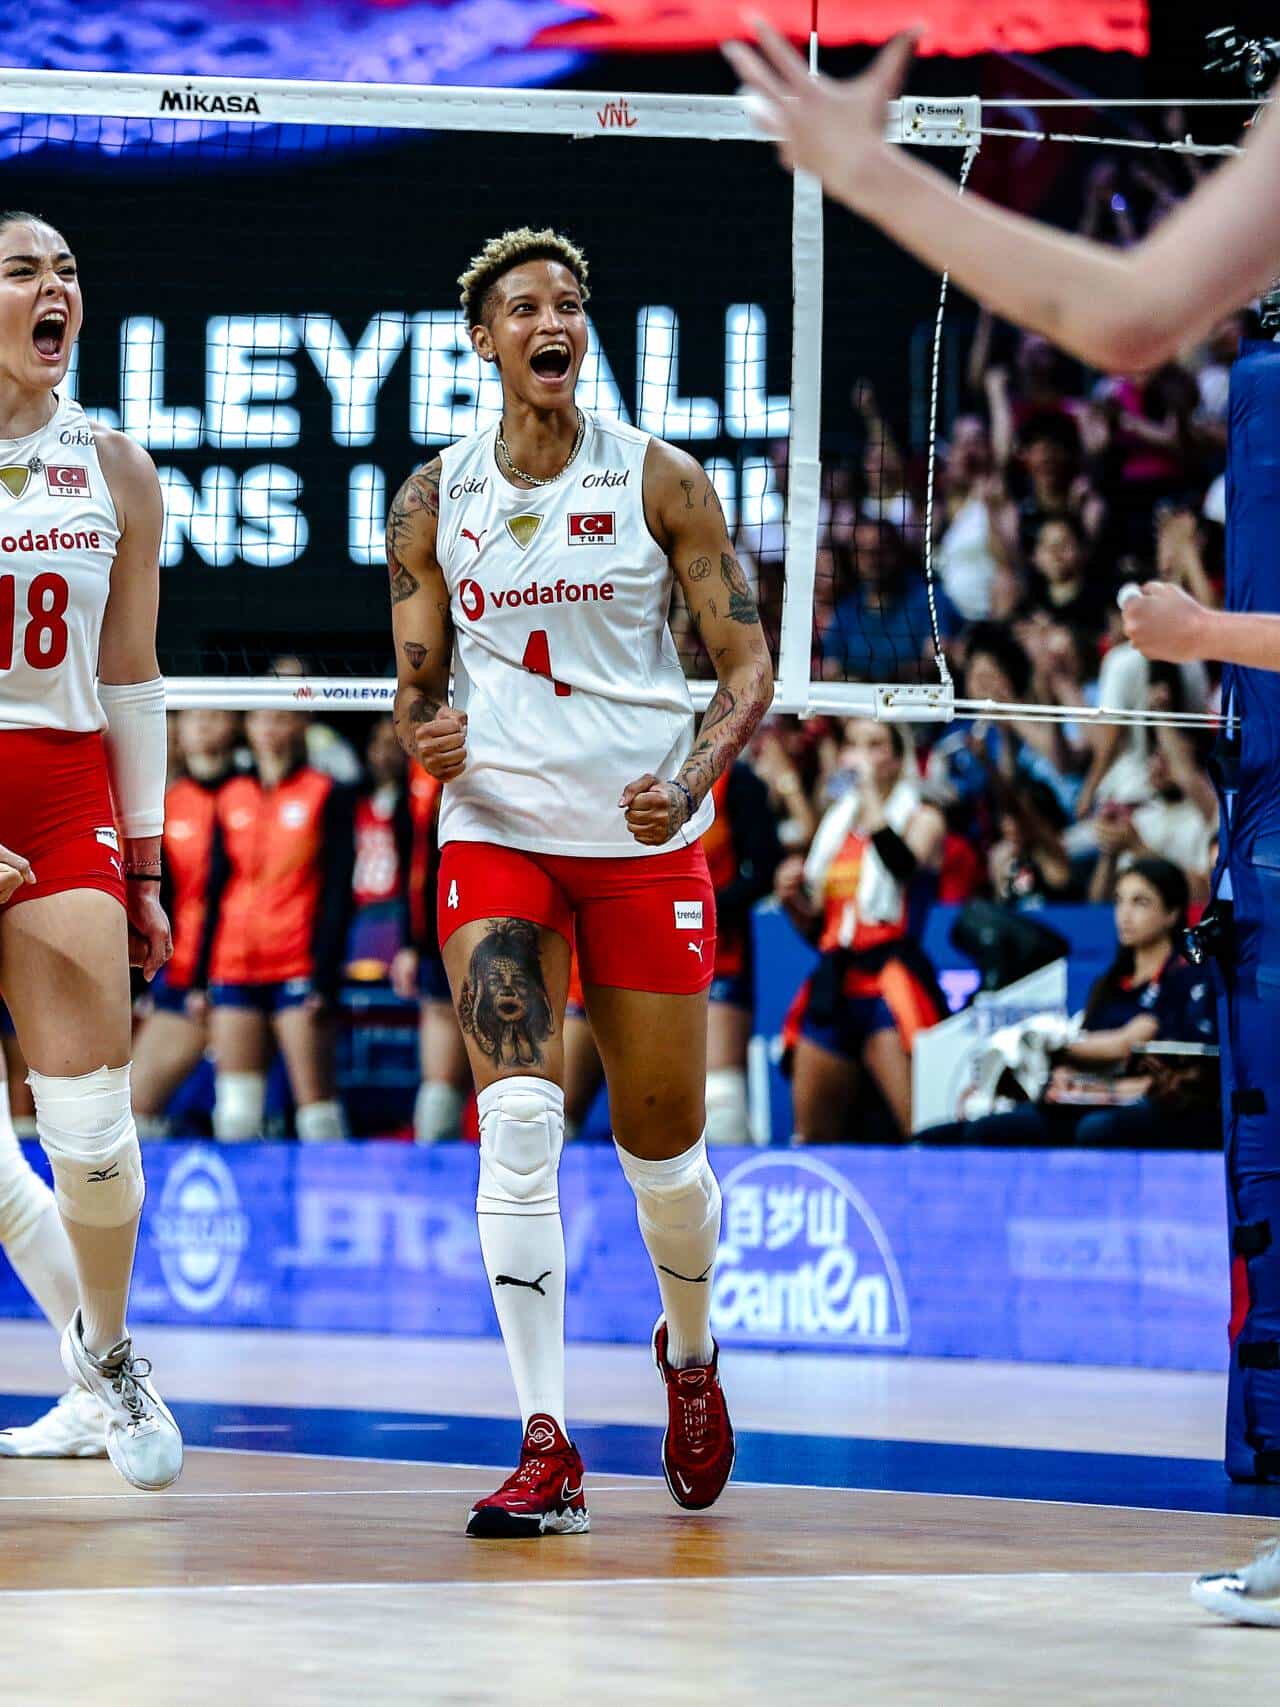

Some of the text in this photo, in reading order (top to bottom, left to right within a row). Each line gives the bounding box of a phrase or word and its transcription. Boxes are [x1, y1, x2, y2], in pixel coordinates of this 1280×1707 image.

[596, 97, 639, 129] VNL
[582, 469, 630, 489] Orkid
[58, 487, 81, 496] TUR
[490, 579, 614, 608] vodafone
[322, 687, 397, 700] VOLLEYBA
[447, 879, 459, 909] 4
